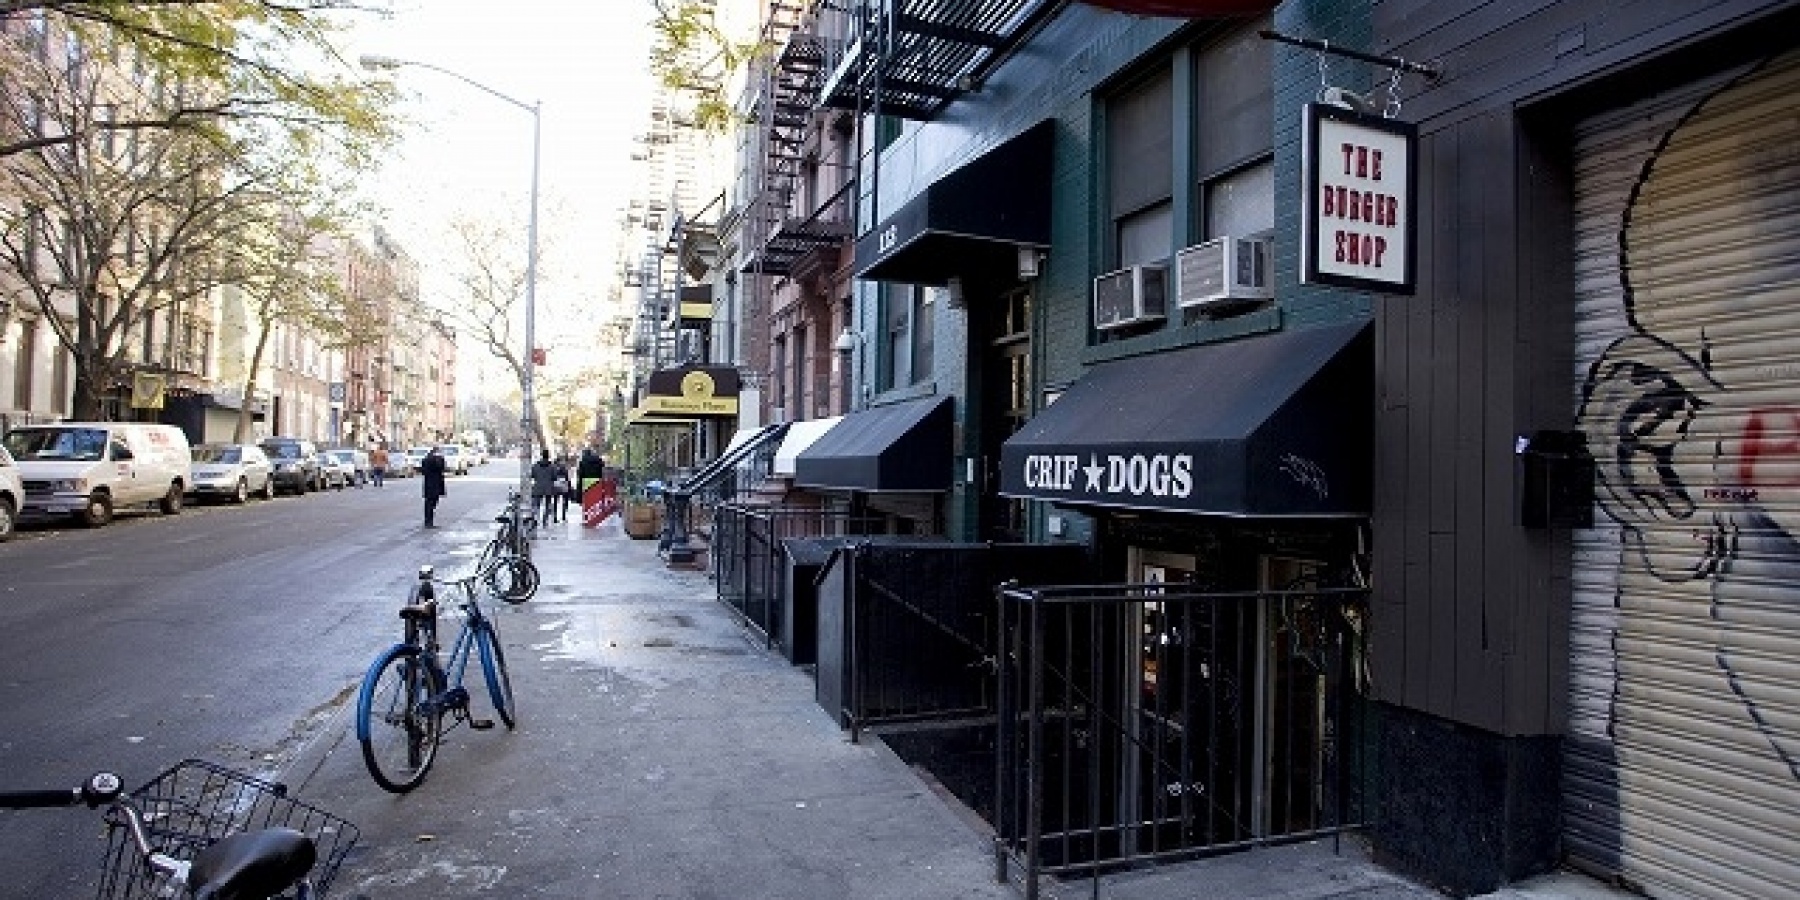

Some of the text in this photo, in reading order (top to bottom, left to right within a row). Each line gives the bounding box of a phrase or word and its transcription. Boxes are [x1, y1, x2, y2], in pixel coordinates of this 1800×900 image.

[1341, 143, 1382, 181] THE
[1323, 183, 1398, 228] BURGER
[1335, 230, 1387, 268] SHOP
[1024, 453, 1193, 498] CRIF DOGS
